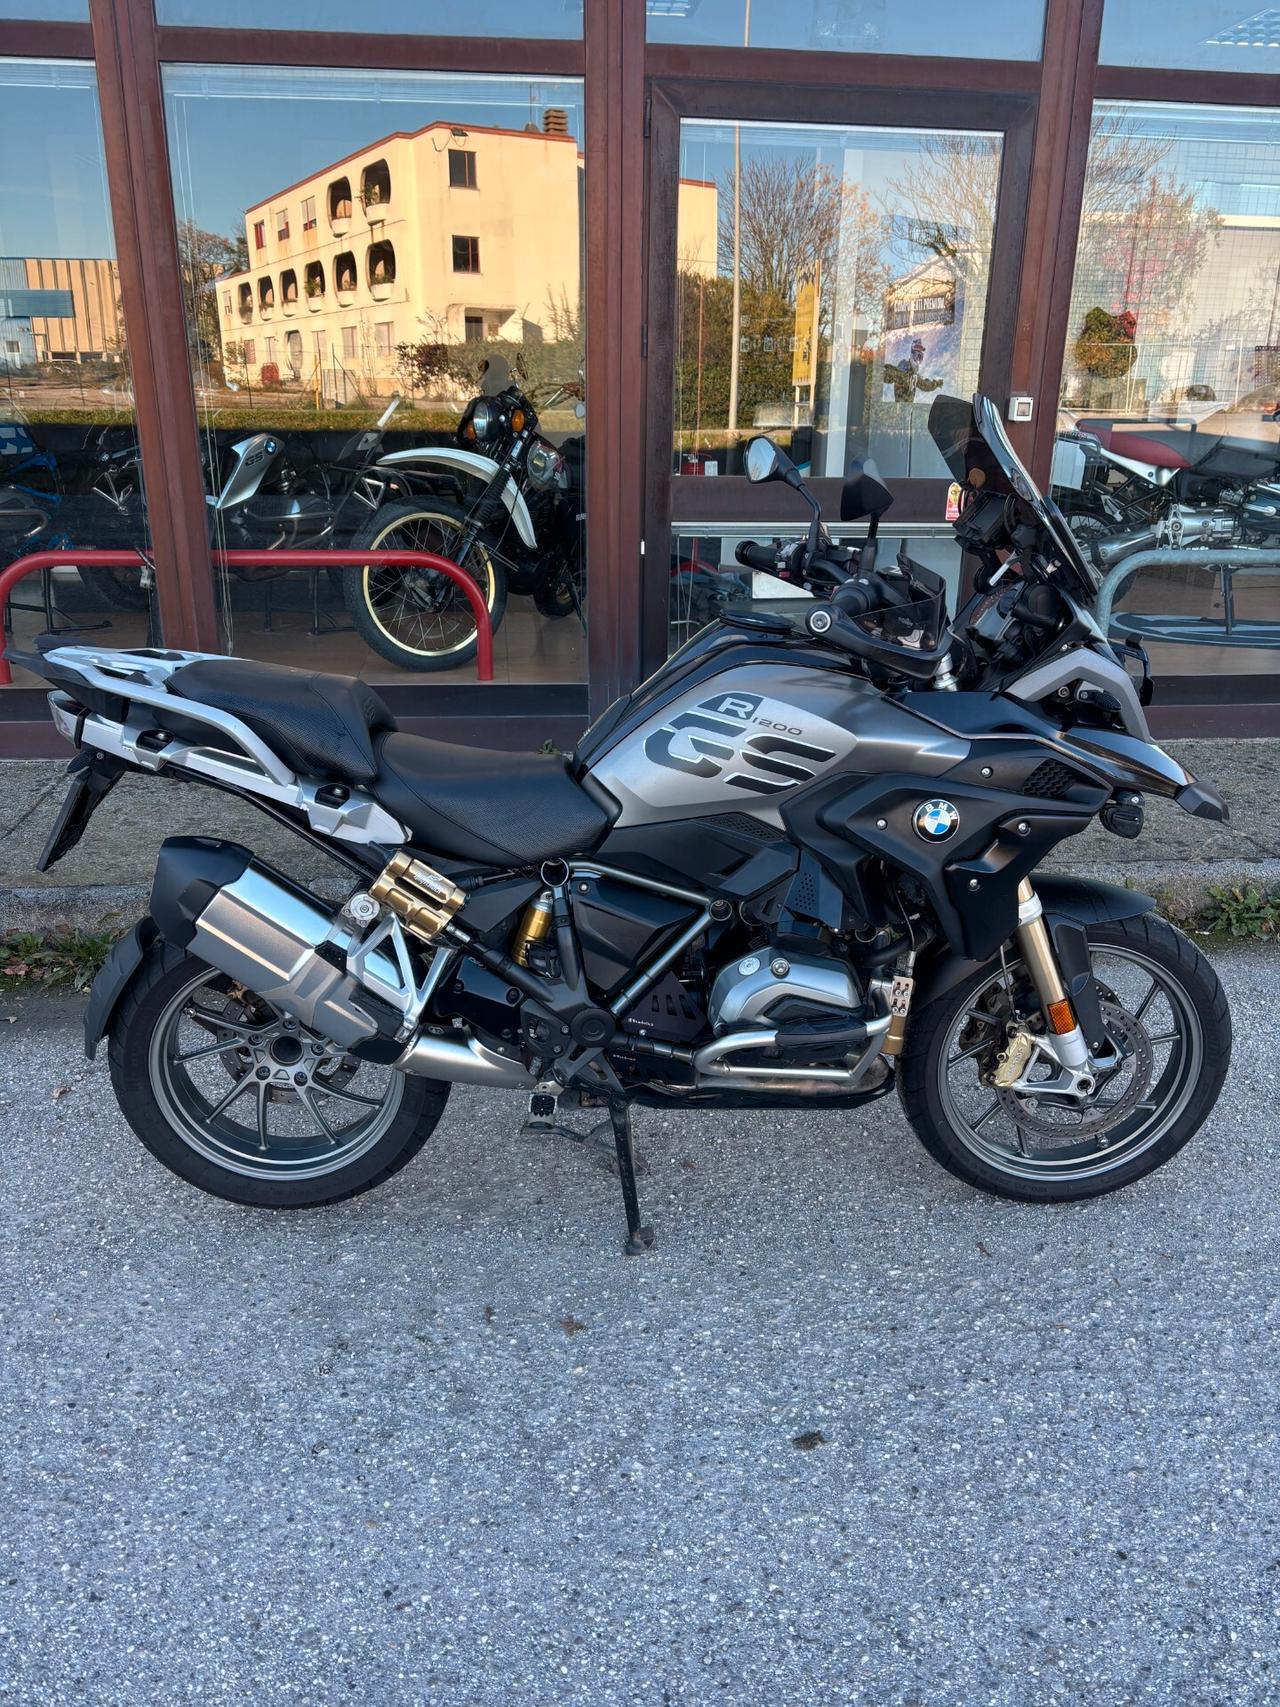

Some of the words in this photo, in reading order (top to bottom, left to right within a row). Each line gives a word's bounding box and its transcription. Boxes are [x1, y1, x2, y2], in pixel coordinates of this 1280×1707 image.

[717, 697, 754, 719] R
[752, 716, 803, 736] 1200
[643, 711, 837, 795] GS
